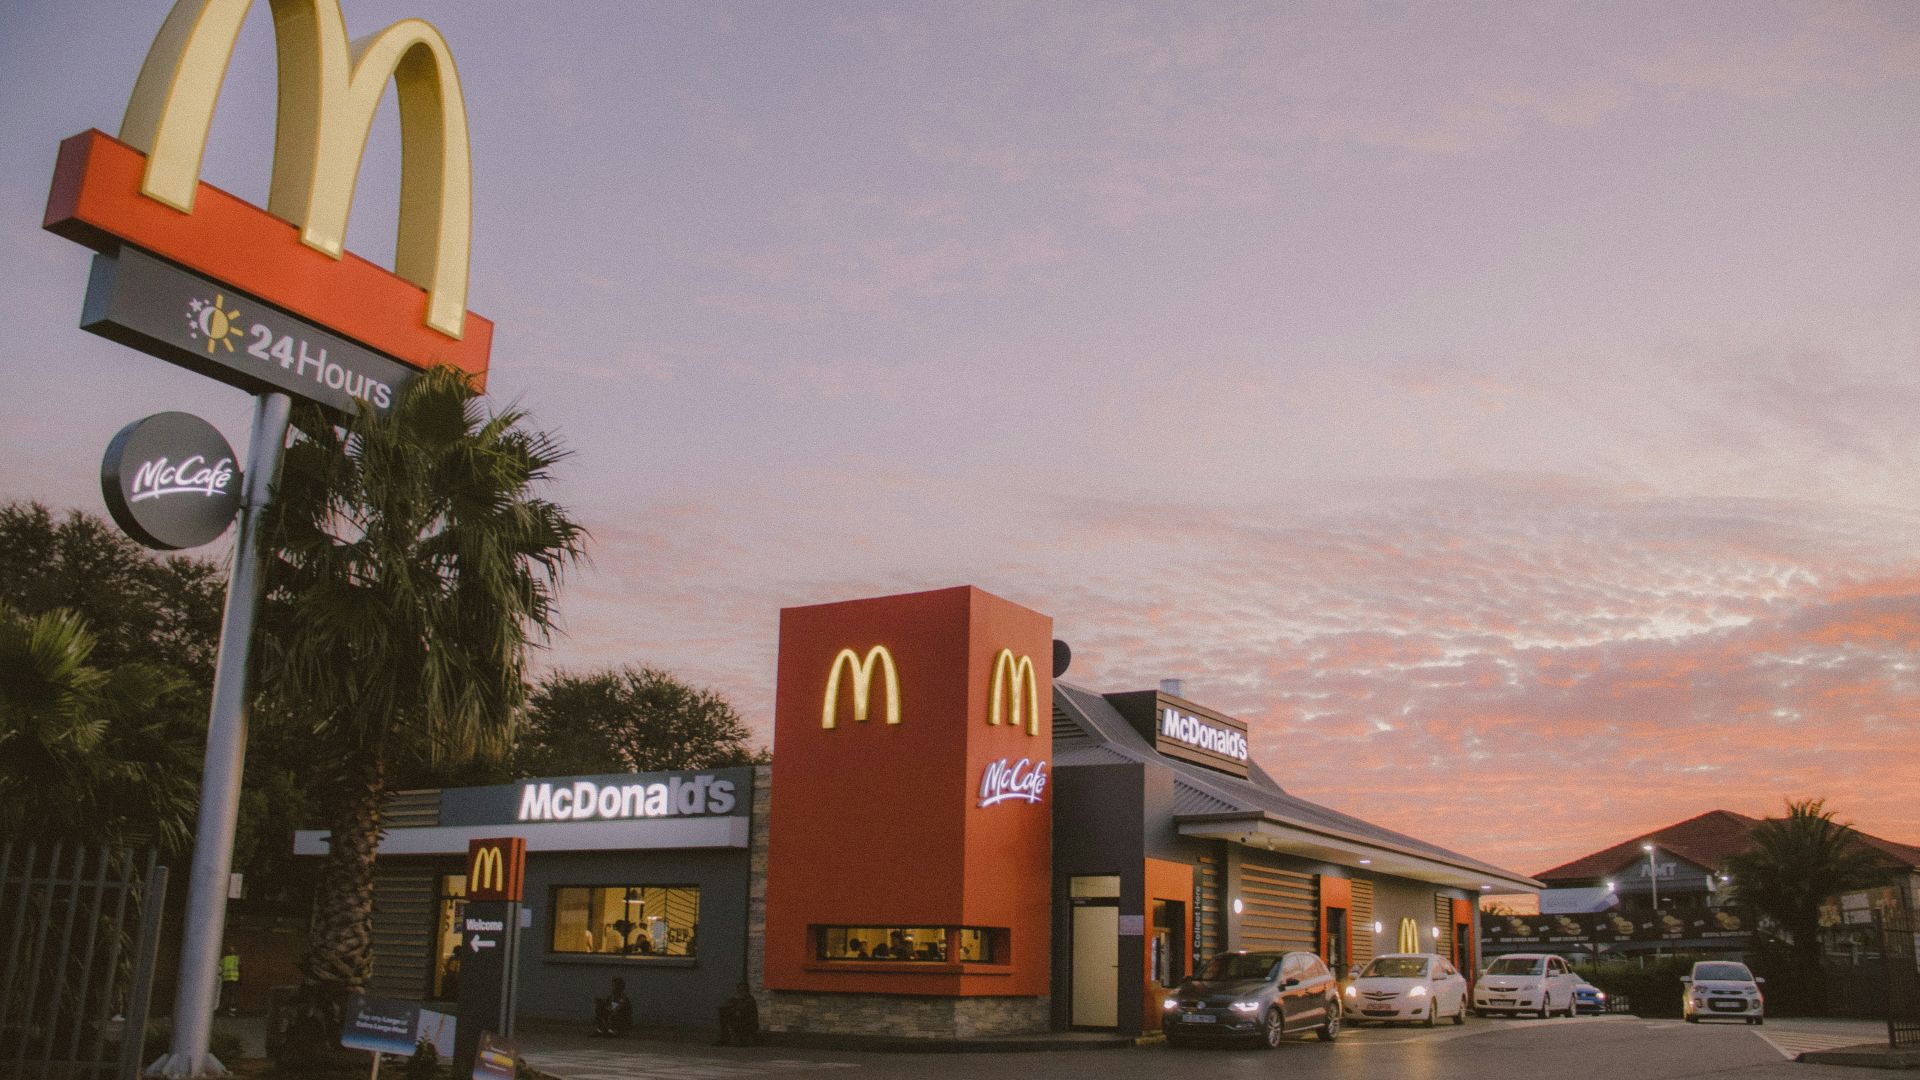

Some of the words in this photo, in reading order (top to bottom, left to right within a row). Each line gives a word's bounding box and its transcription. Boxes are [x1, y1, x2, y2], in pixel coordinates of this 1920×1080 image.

[131, 455, 232, 501] McCafé
[1161, 708, 1247, 760] McDonald's
[518, 775, 736, 820] McDonald's
[979, 758, 1046, 806] McCafé
[466, 918, 503, 931] Welcome
